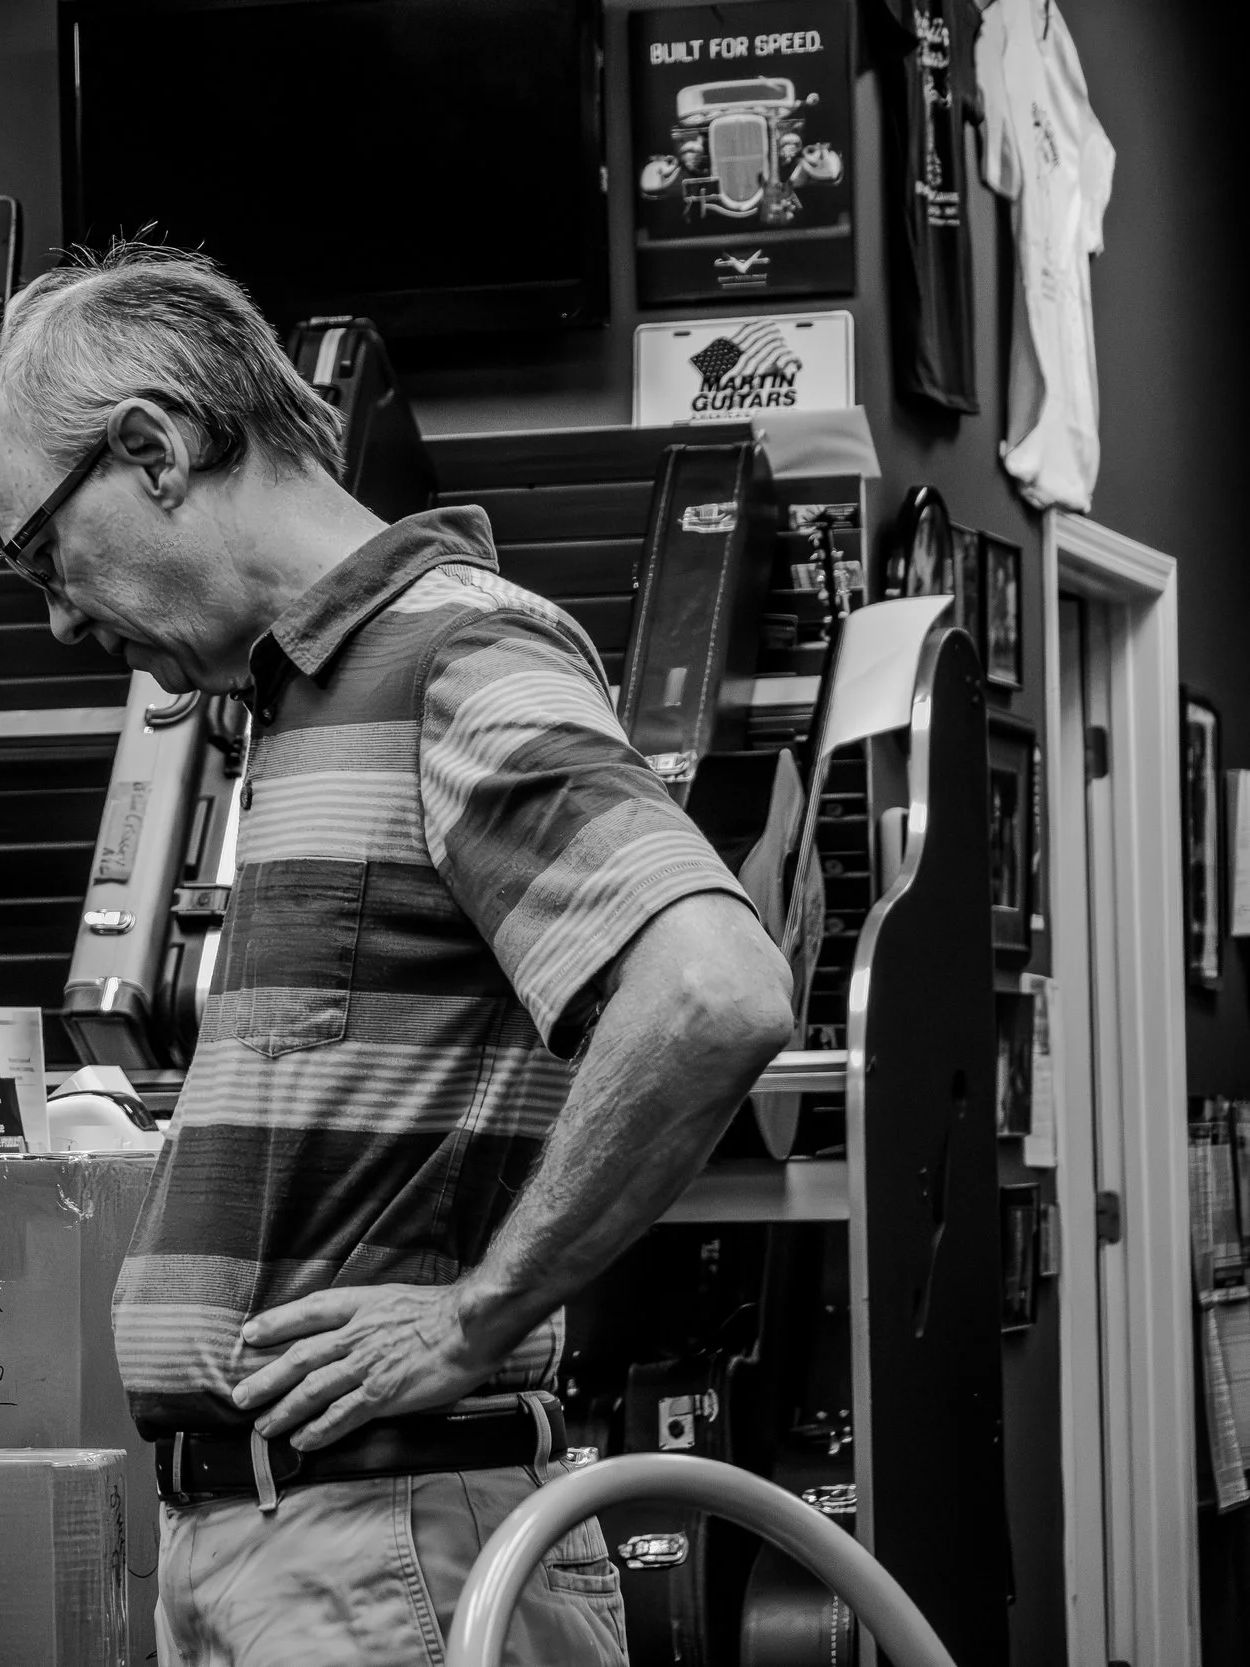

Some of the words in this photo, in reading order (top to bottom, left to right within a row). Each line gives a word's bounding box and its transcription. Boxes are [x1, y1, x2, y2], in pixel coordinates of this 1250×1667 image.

[650, 39, 704, 65] BUILT
[709, 36, 749, 60] FOR
[700, 371, 796, 393] MARTIN
[692, 388, 797, 412] GUITARS
